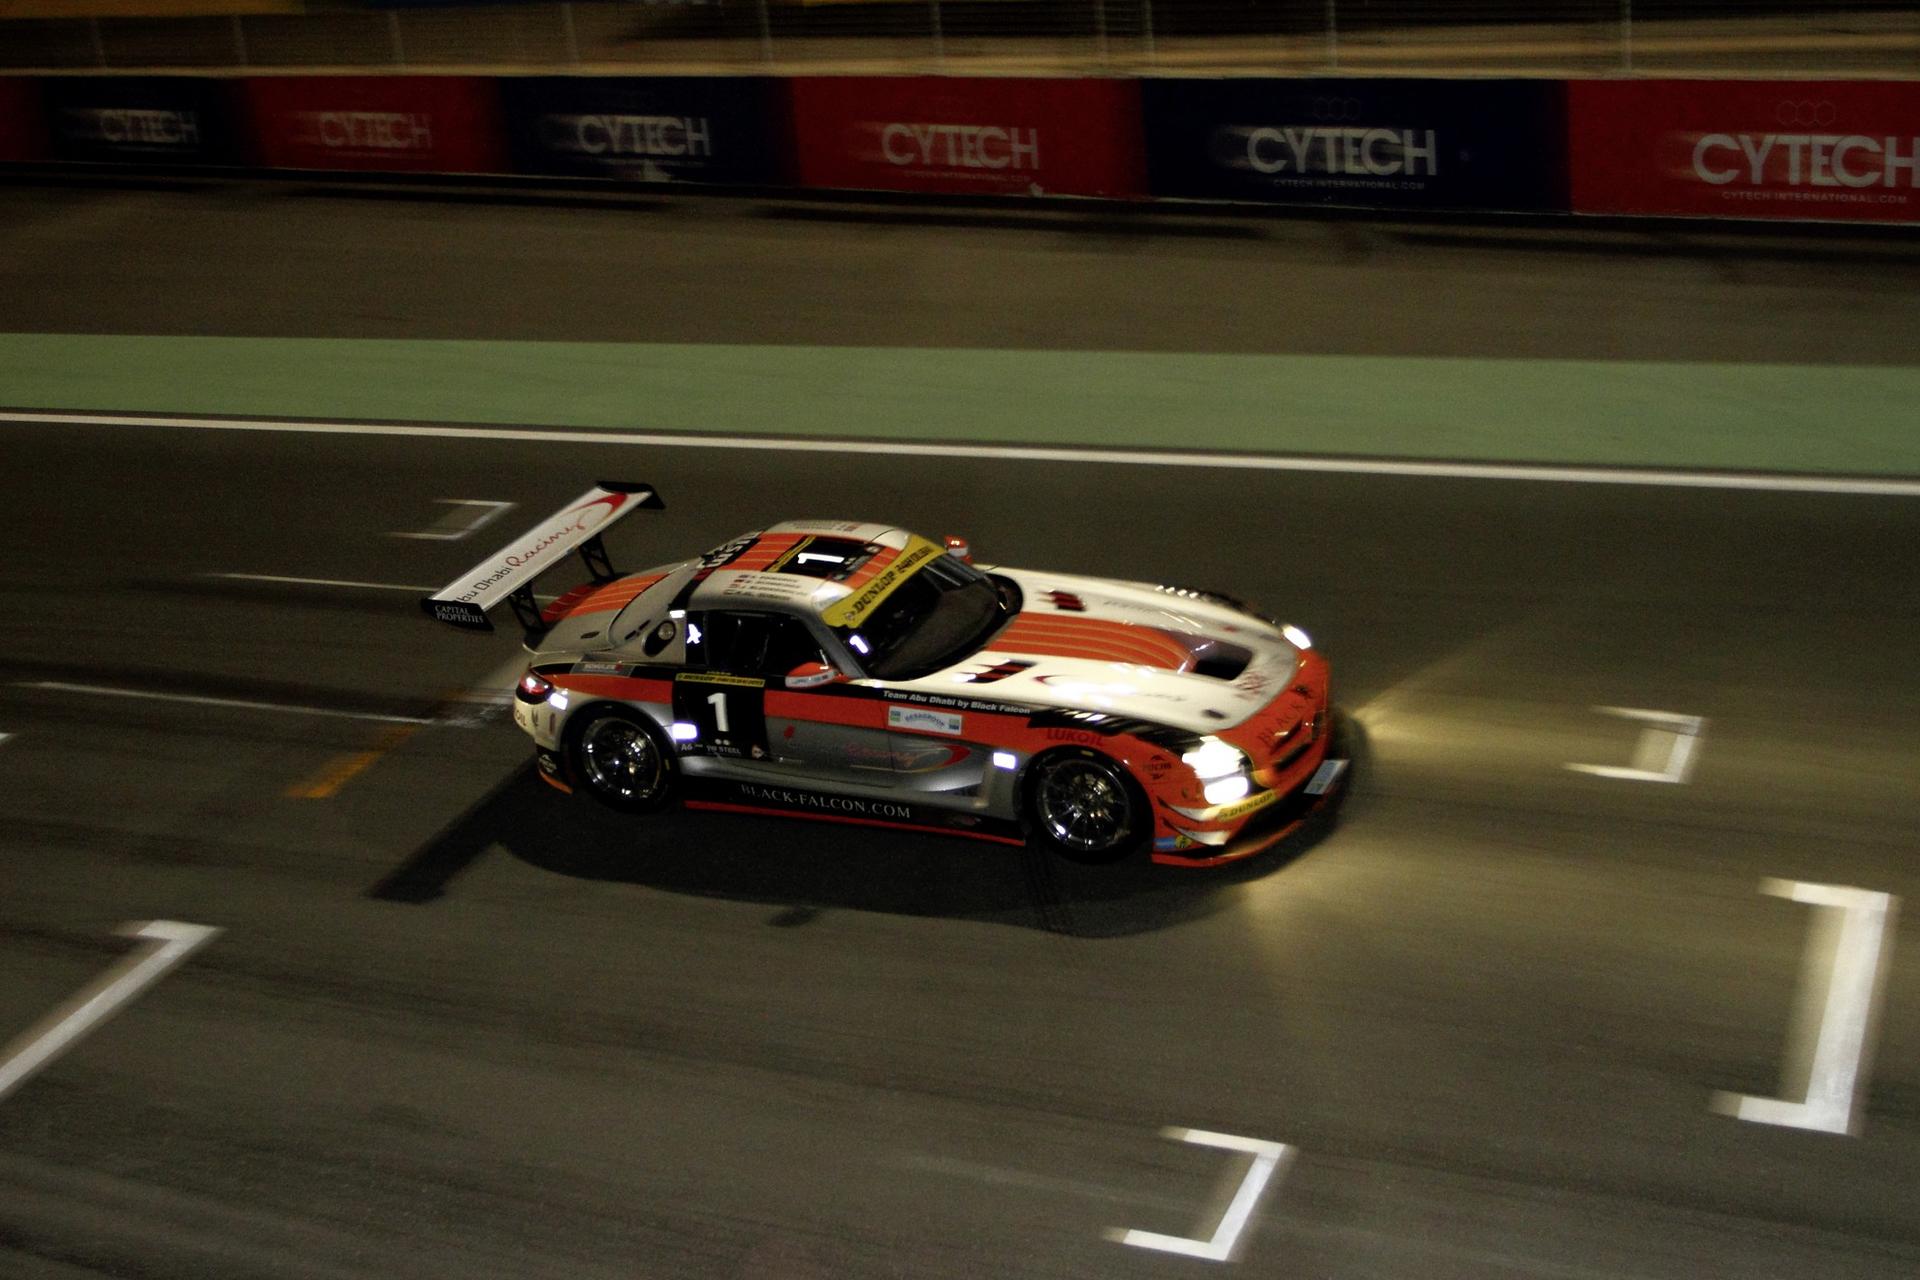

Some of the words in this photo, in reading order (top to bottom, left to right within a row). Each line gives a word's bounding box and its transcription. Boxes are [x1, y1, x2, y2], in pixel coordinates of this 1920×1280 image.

[100, 108, 199, 143] CYTECH
[319, 111, 433, 149] CYTECH
[577, 114, 711, 156] CYTECH
[881, 123, 1040, 169] CYTECH
[1247, 127, 1437, 176] CYTECH
[1692, 133, 1920, 188] CYTECH
[434, 604, 470, 615] CAPITAL
[456, 591, 479, 602] bu
[853, 571, 896, 613] DUNLOP
[435, 612, 485, 624] PROPERTIES
[706, 692, 731, 732] 1
[882, 690, 907, 700] Team
[909, 693, 928, 703] Abu
[929, 695, 956, 706] Dhabi
[957, 699, 969, 709] by
[970, 701, 997, 711] Black
[999, 704, 1031, 715] Falcon
[1047, 728, 1105, 747] LUKOIL
